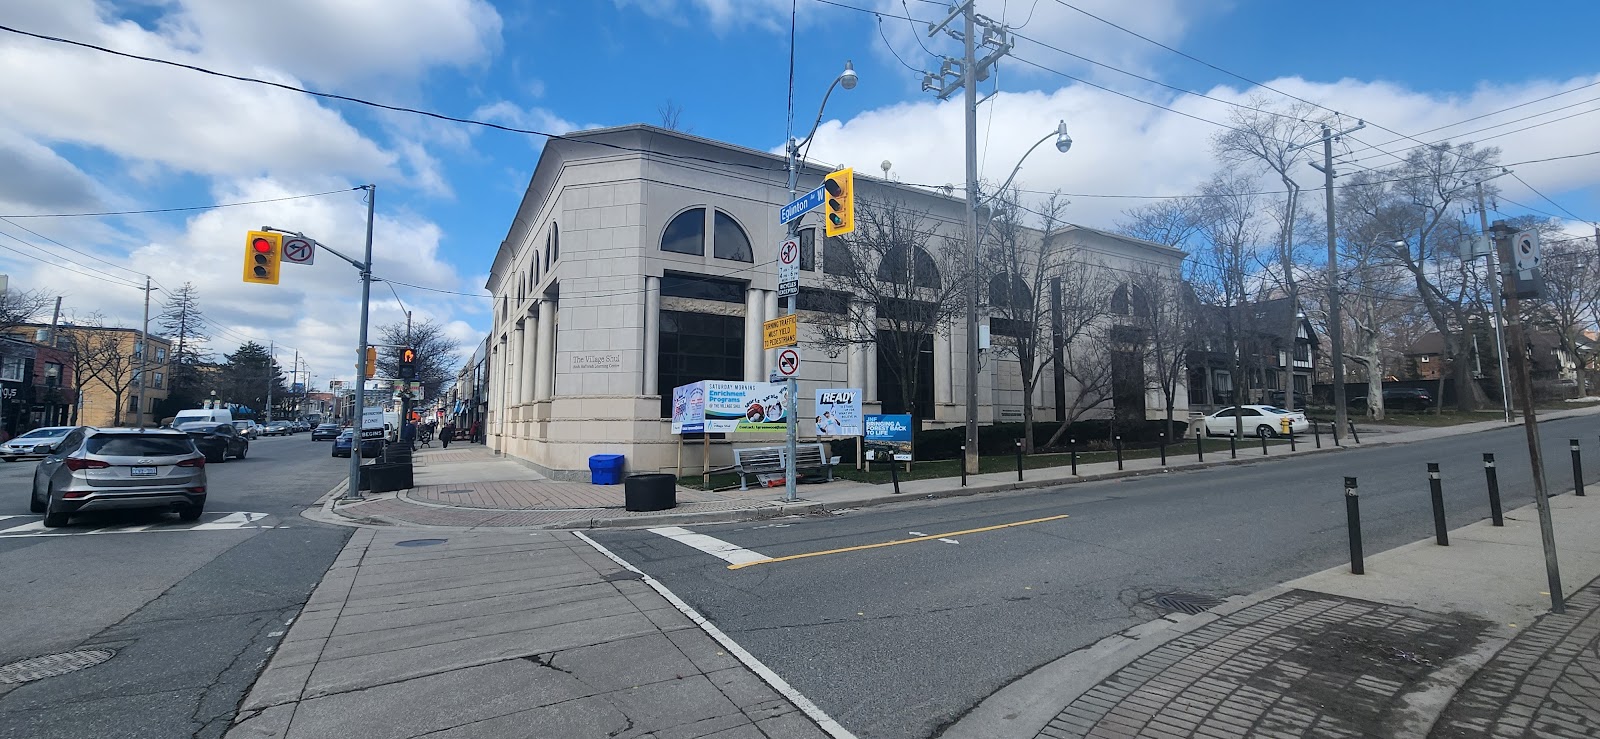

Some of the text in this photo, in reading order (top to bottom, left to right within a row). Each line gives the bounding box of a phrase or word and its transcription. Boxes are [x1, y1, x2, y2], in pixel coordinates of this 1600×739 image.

[782, 200, 808, 220] Eglinton
[817, 188, 824, 201] W
[780, 317, 796, 327] TRAFFIC
[769, 327, 790, 338] MUST YIELD
[770, 335, 795, 346] PEDESTRIANS
[585, 355, 604, 364] Village
[822, 392, 856, 403] READY
